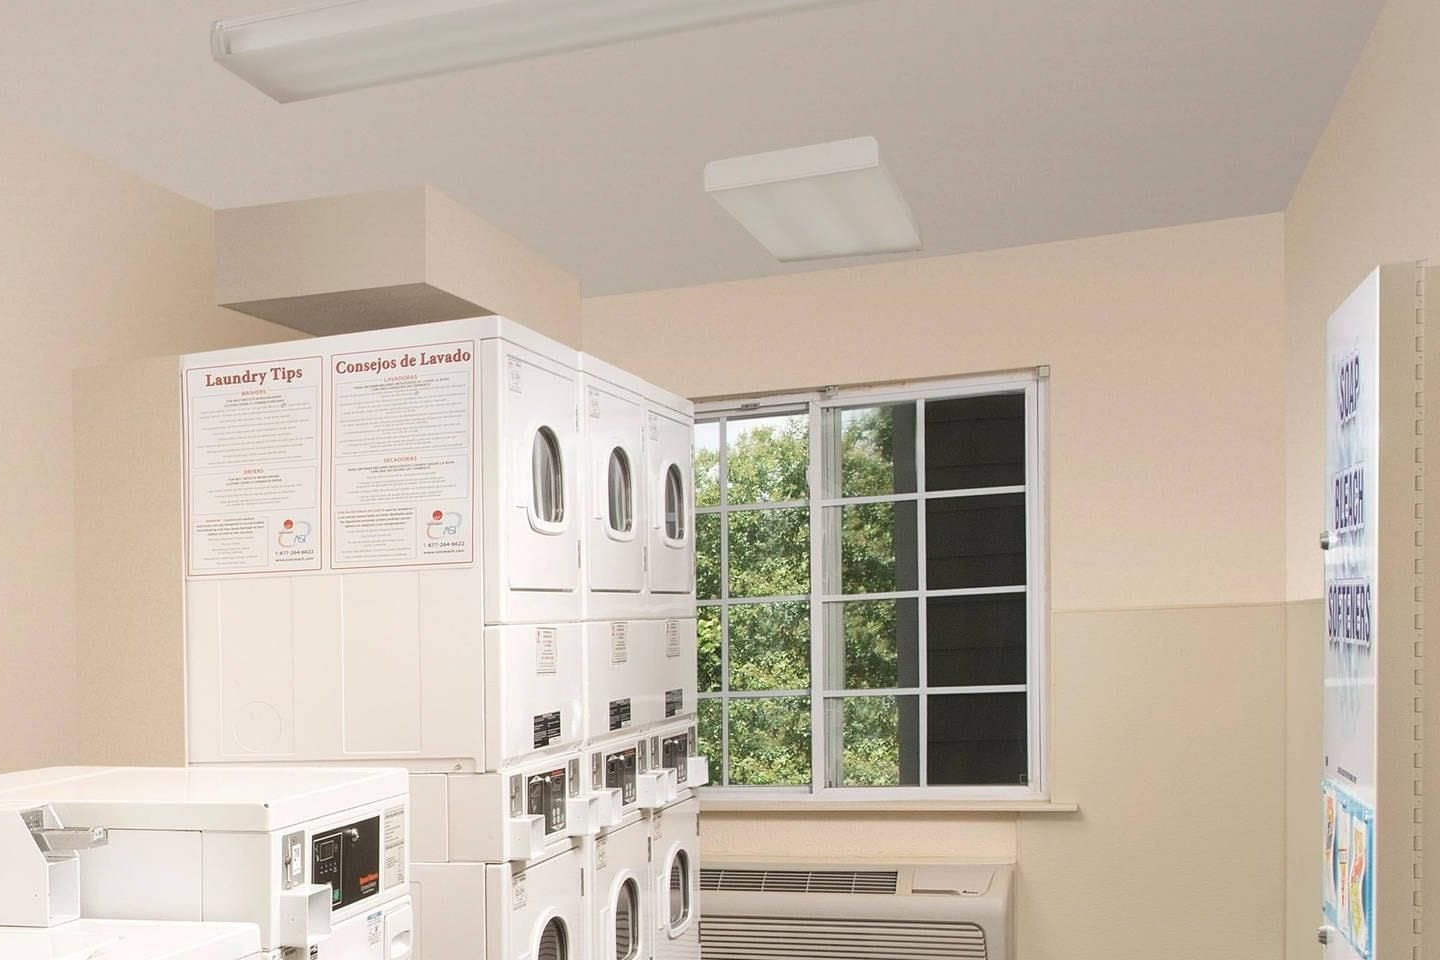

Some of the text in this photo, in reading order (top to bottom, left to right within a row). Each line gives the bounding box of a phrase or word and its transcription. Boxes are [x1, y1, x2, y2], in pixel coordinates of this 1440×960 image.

[206, 367, 303, 388] Laundry Tips
[336, 349, 471, 374] Consejos de Lavado
[1339, 355, 1361, 421] SOAP
[1334, 468, 1365, 531] BLEACH
[1327, 581, 1371, 645] SOFTENERS
